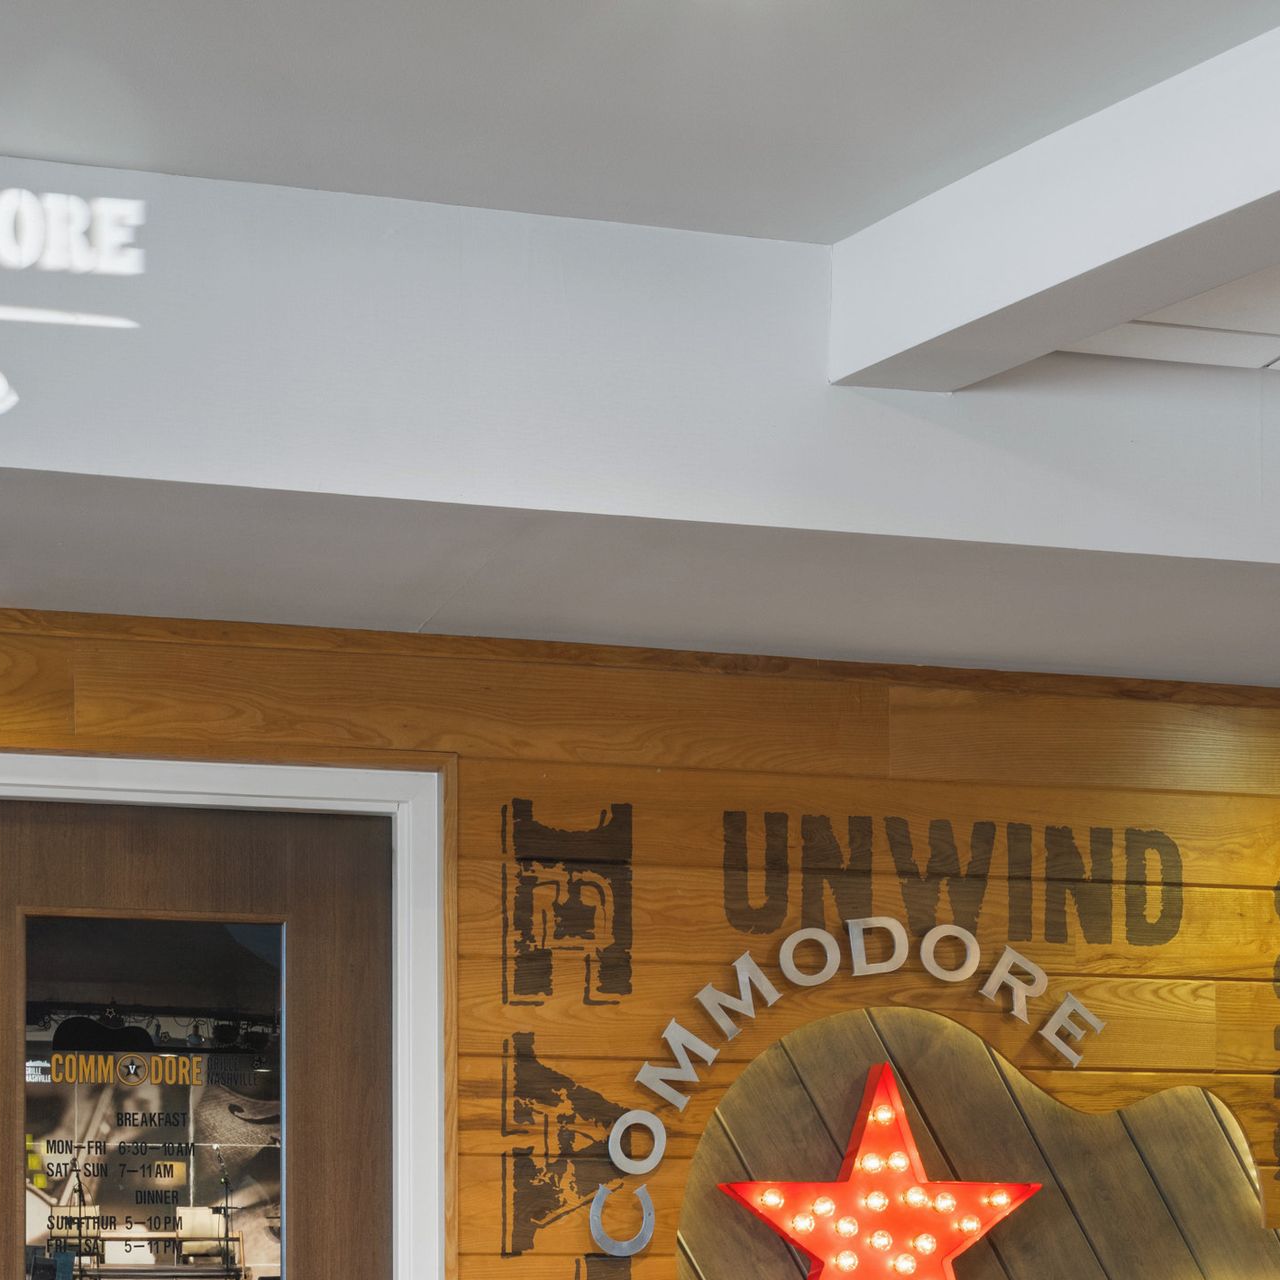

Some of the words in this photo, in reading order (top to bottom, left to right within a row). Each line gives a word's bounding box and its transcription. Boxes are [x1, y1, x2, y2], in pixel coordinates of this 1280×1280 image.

[723, 811, 1184, 947] UNWIND
[116, 1112, 187, 1128] BREAKFAST
[589, 916, 1108, 1257] COMMODORE
[135, 1190, 179, 1205] DINNER
